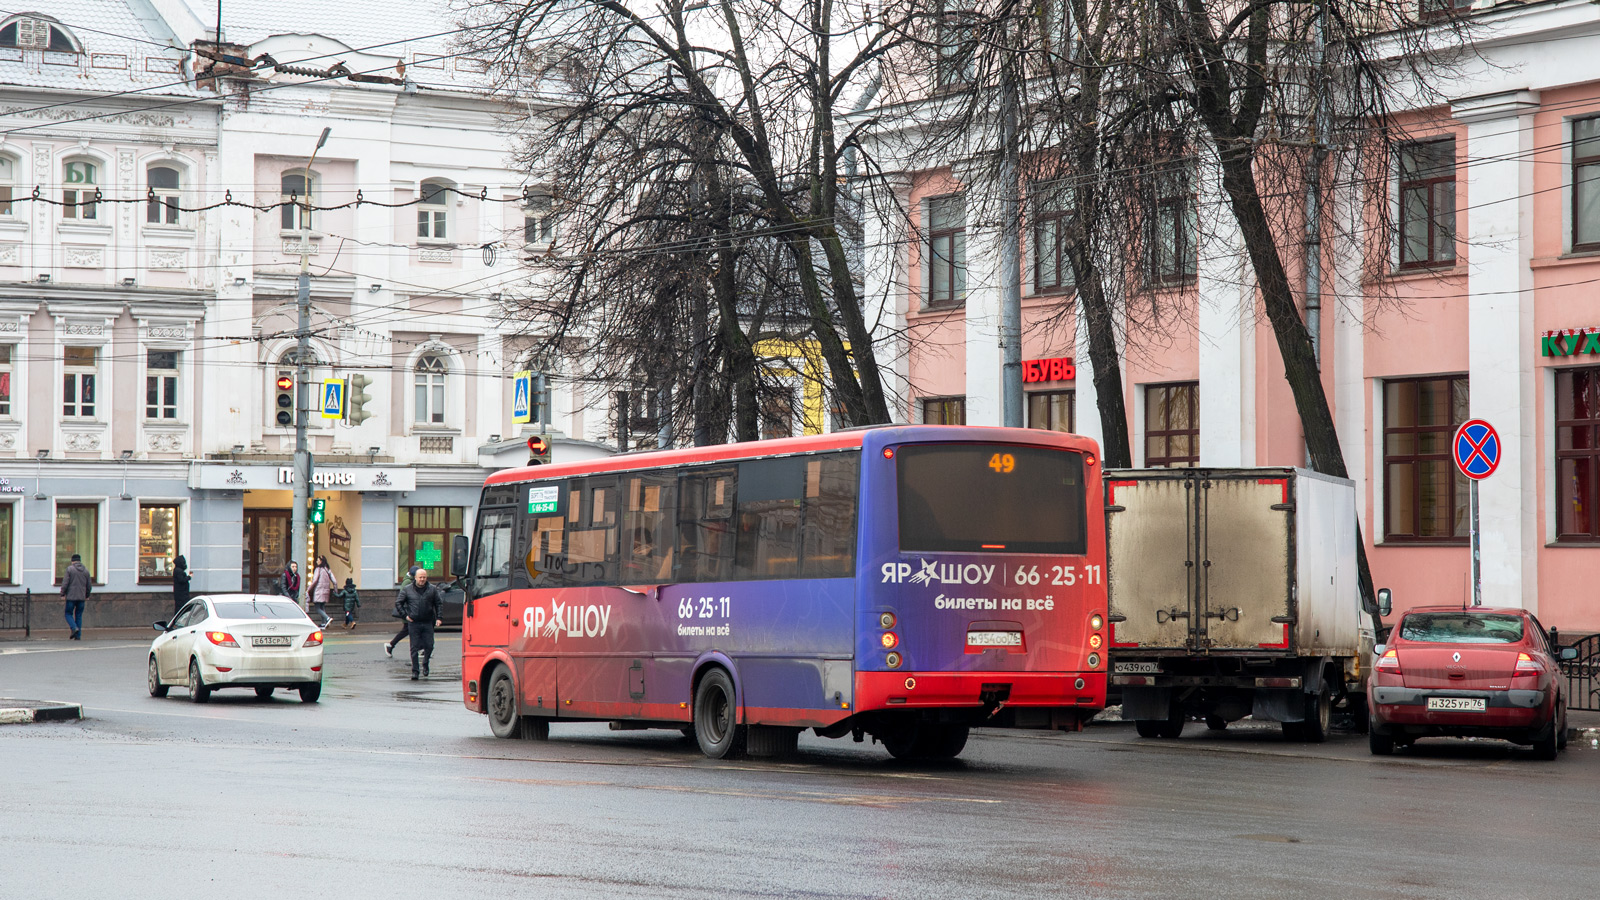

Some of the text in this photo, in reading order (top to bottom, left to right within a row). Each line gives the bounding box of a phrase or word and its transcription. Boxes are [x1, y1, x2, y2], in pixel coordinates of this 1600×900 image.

[988, 453, 1015, 473] 49
[277, 467, 356, 489] Парня
[317, 500, 324, 510] 3
[881, 562, 912, 584] ЯР
[941, 563, 996, 585] ШОУ
[934, 594, 1055, 611] билеты на всё
[523, 604, 612, 638] ЯР ШОУ
[677, 623, 730, 636] билеты на всё
